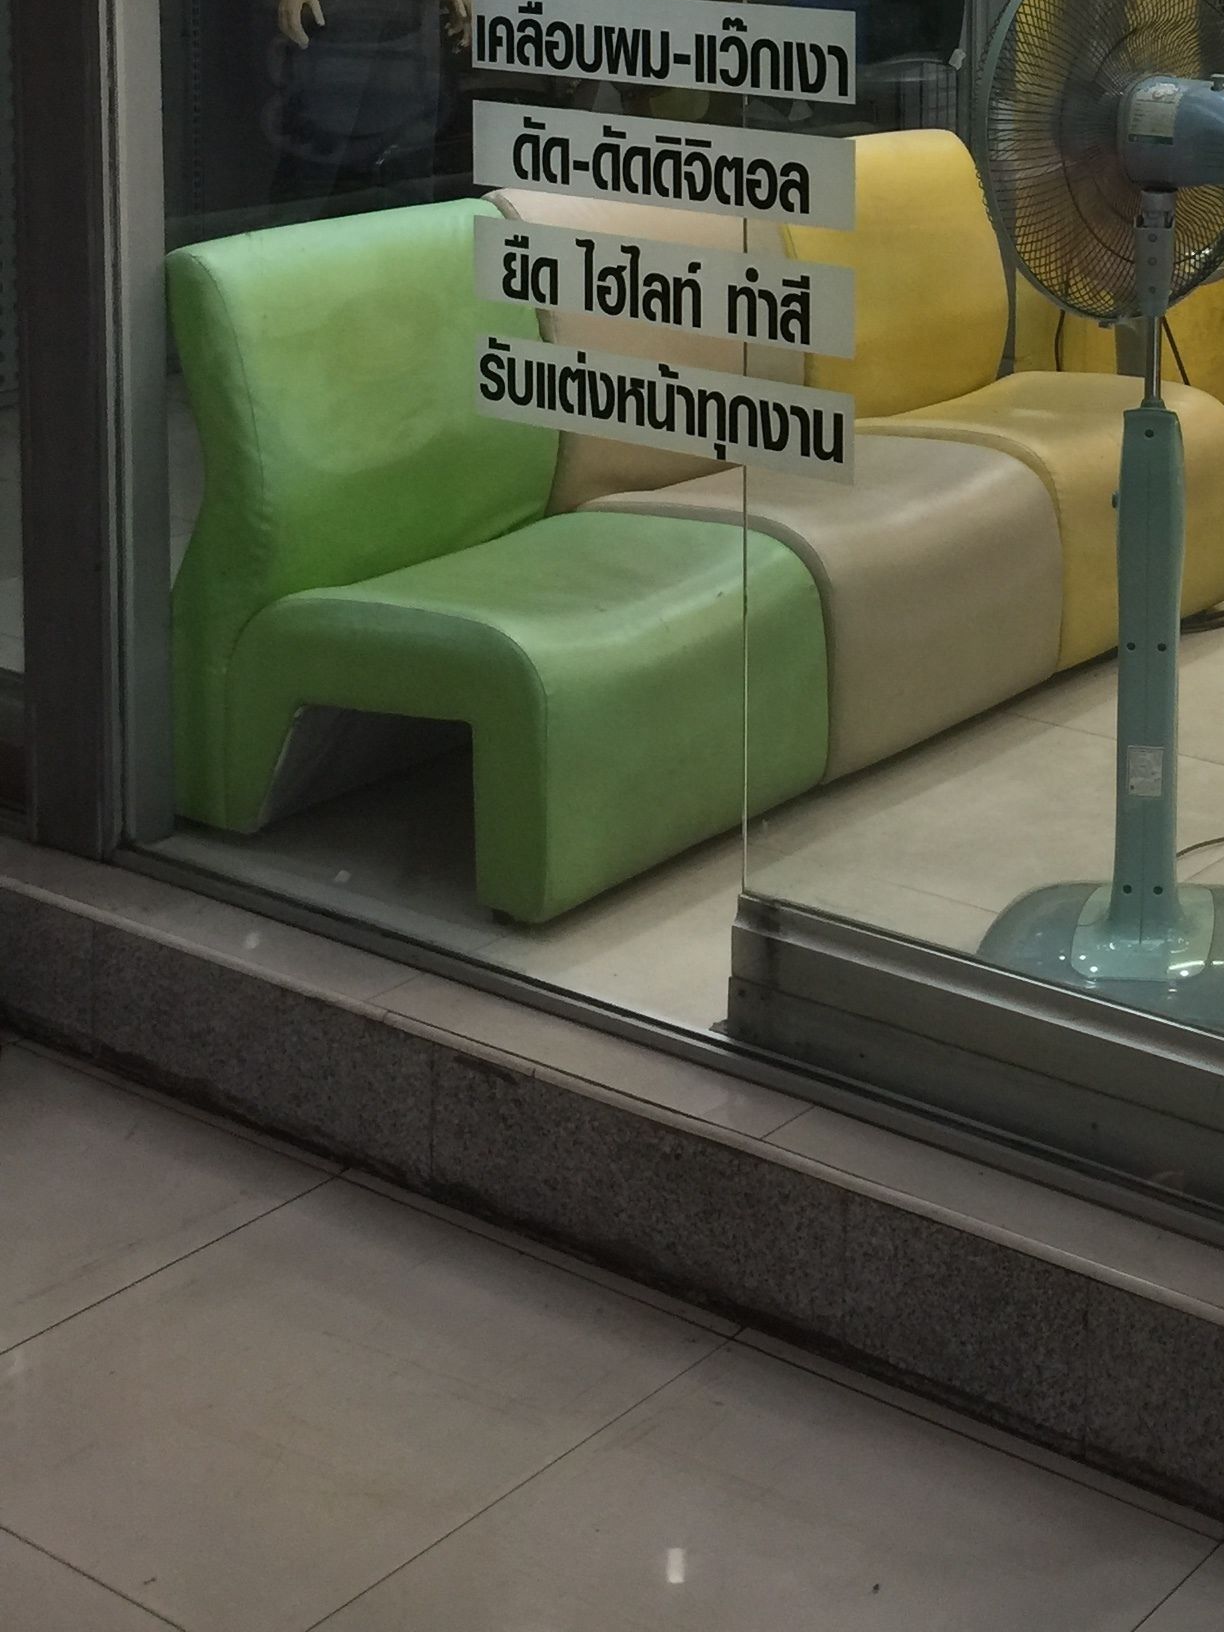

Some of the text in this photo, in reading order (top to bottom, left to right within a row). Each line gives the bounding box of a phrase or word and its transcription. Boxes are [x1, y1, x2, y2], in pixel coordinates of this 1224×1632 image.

[476, 0, 849, 97] เคลือบผม-แว๊กเงา
[512, 116, 810, 215] ดัด-ดัดดิจิตอล
[502, 234, 811, 344] ยืด ไฮไลท์ ทำสี
[479, 338, 844, 464] รับแต่งหน้าทุกงาน
